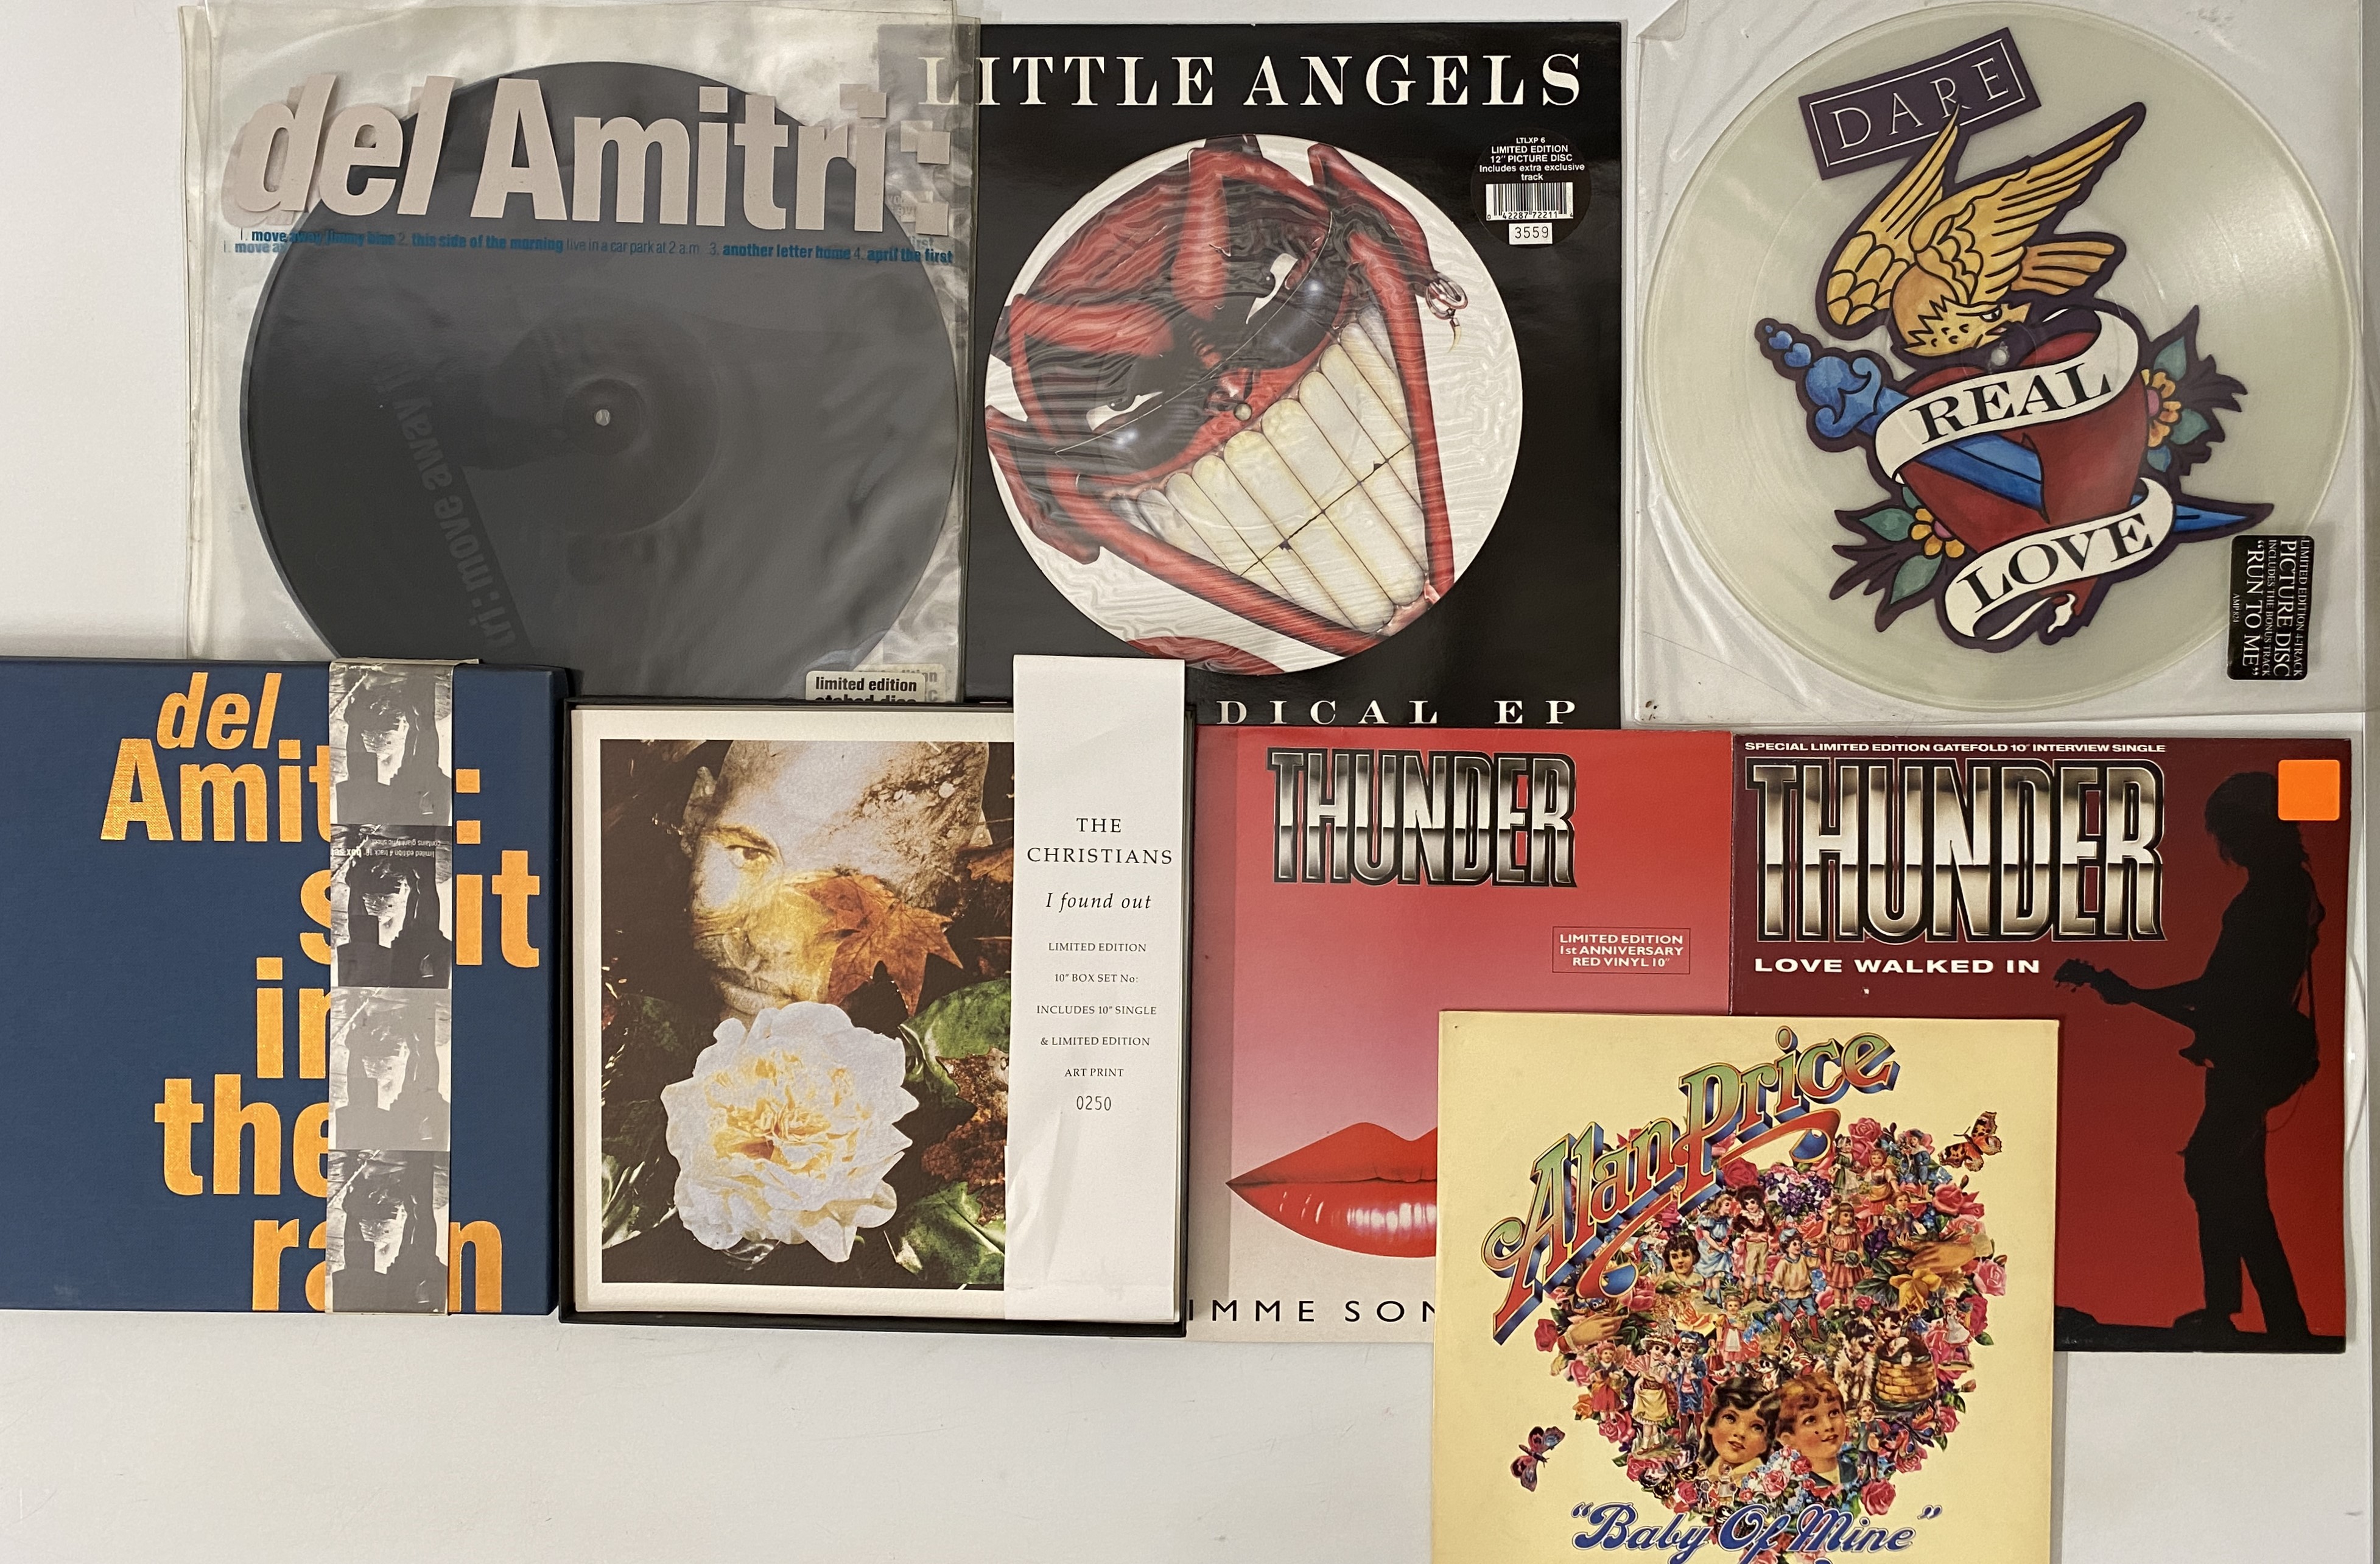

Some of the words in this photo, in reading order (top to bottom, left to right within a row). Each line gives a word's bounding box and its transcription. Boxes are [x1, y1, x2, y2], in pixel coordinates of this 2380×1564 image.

[918, 56, 1213, 106] LITTLE
[1243, 54, 1581, 107] ANGELS
[1828, 57, 2009, 150] DARE
[236, 73, 455, 217] del
[470, 77, 950, 236] Amitri:
[252, 231, 286, 242] move
[469, 234, 483, 248] of
[486, 235, 506, 249] the
[510, 236, 563, 253] morning
[567, 238, 585, 251] live
[589, 239, 599, 251] in
[601, 242, 608, 252] a
[611, 241, 626, 253] car
[630, 241, 653, 255] park
[656, 242, 666, 254] at
[669, 241, 675, 253] 2
[723, 244, 774, 256] another
[777, 244, 813, 258] letter
[925, 248, 953, 263] first
[1515, 226, 1549, 239] 3559
[1909, 362, 2111, 445] REAL
[1957, 514, 2154, 614] LOVE
[2267, 540, 2277, 586] INCLUDES
[2299, 540, 2310, 585] LIMITED
[2266, 589, 2275, 608] THE
[2277, 540, 2297, 628] PICTURE
[2245, 600, 2262, 629] TO
[2296, 588, 2307, 631] EDITION
[2264, 611, 2274, 643] BONUS
[2262, 646, 2271, 676] TRACK
[2273, 632, 2291, 677] DISC
[2294, 633, 2304, 676] 4-TRACK
[815, 677, 865, 691] limited
[869, 678, 917, 692] edition
[156, 672, 281, 749] del
[1216, 700, 1437, 725] DICAL
[1494, 700, 1576, 725] EP
[1744, 742, 1808, 751] SPECIAL
[1811, 743, 1869, 752] LIMITED
[1932, 744, 2007, 752] GATEFOLD
[2032, 744, 2110, 752] INTERVIEW
[2111, 744, 2166, 753] SINGLE
[1076, 817, 1122, 833] THE
[1266, 747, 1578, 887] THUNDER
[1027, 847, 1173, 864] CHRISTIANS
[1746, 757, 2167, 942] THUNDER
[1045, 892, 1053, 908] I
[1058, 892, 1114, 913] found
[1122, 895, 1151, 909] out
[1048, 943, 1095, 951] LIMITED
[1098, 943, 1146, 952] EDITION
[1560, 934, 1618, 943] LIMITED
[1621, 935, 1683, 944] EDITION
[1560, 946, 1577, 955] 1st
[1579, 946, 1683, 956] ANNIVERSARY
[1573, 957, 1601, 967] RED
[1604, 957, 1649, 967] VINYL
[1652, 958, 1670, 967] 10"
[1754, 958, 1842, 973] LOVE
[1854, 959, 1994, 973] WALKED
[2007, 959, 2040, 973] IN
[1055, 974, 1069, 982] 10"
[1072, 974, 1095, 982] BOX
[1120, 974, 1139, 983] No:
[1037, 1006, 1095, 1014] INCLUDES
[1098, 1006, 1112, 1014] 10"
[1115, 1006, 1157, 1015] SINGLE
[1052, 1037, 1099, 1046] LIMITED
[1102, 1037, 1150, 1046] EDITION
[1064, 1068, 1087, 1077] ART
[1090, 1068, 1124, 1077] PRINT
[1076, 1096, 1111, 1111] 0250
[1481, 1118, 1685, 1345] Alan
[1671, 1025, 1901, 1217] Price
[1189, 1299, 1315, 1322] IMME
[1717, 1503, 1792, 1564] Of
